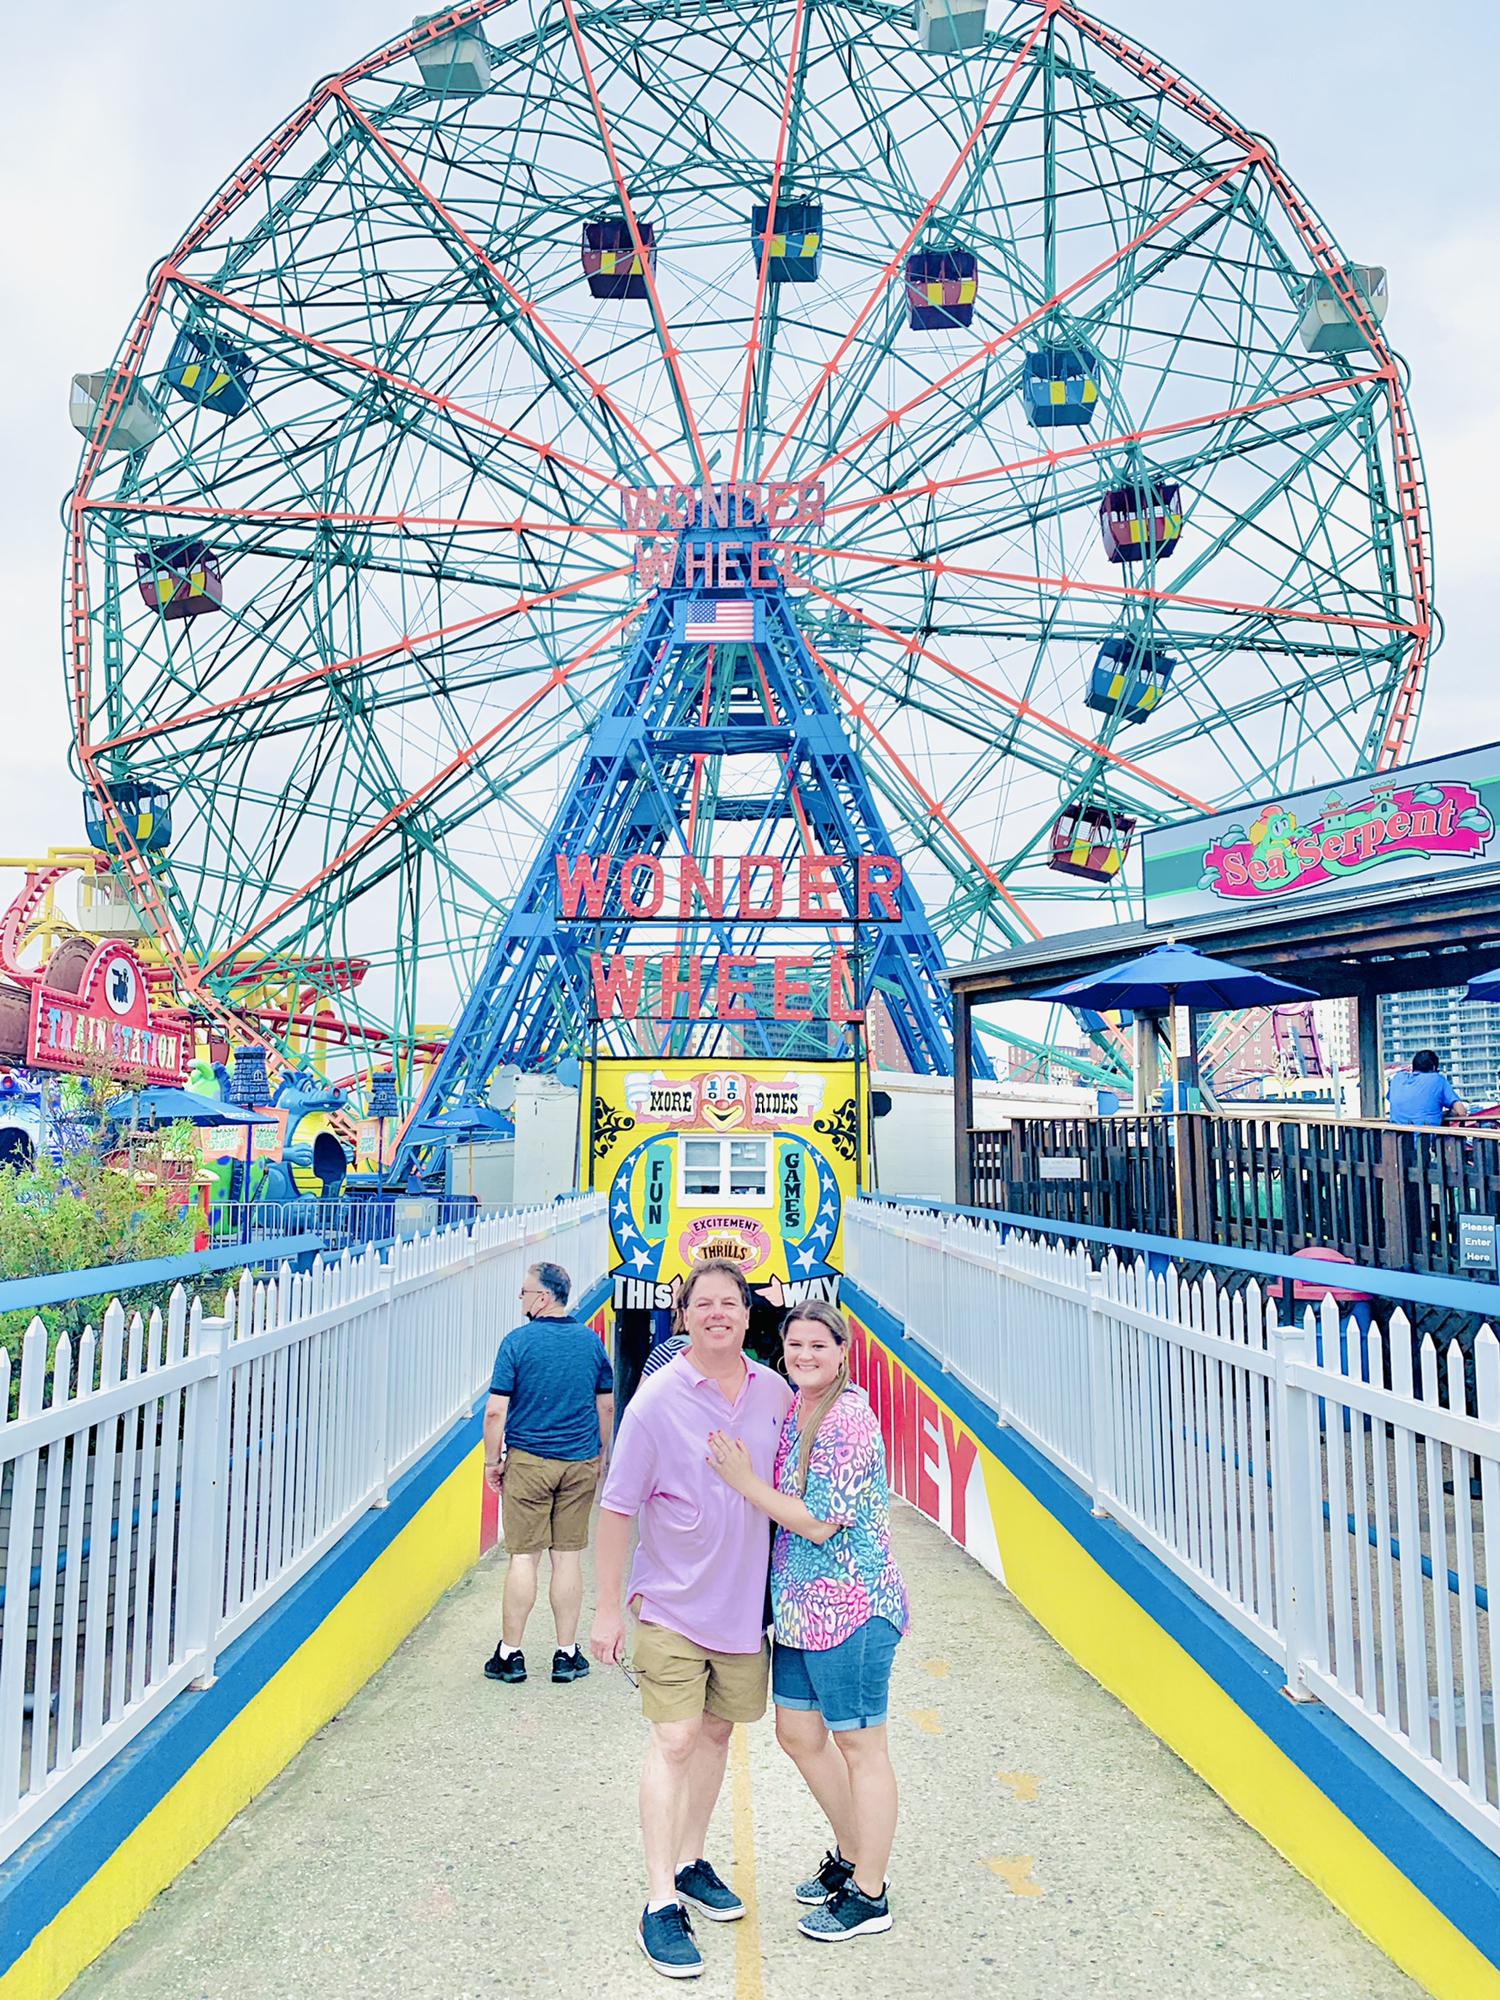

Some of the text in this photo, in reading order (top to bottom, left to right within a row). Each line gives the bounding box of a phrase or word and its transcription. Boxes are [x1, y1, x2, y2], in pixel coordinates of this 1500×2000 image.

[620, 482, 825, 529] WONDER
[633, 541, 811, 588] WHEEL
[1222, 799, 1459, 886] Sea Serpent
[555, 853, 903, 919] WONDER
[590, 953, 863, 1019] WHEEL
[48, 1007, 177, 1069] TRAIN STATION
[650, 1090, 798, 1114] MORE RIDES
[649, 1160, 664, 1224] FUN
[785, 1153, 800, 1227] GAMES
[693, 1218, 759, 1232] EXCITEMENT
[1461, 1222, 1494, 1232] Please
[1464, 1237, 1491, 1246] Enter
[701, 1244, 748, 1260] THRILLS
[1466, 1252, 1490, 1261] Here
[612, 1275, 840, 1309] THIS WAY
